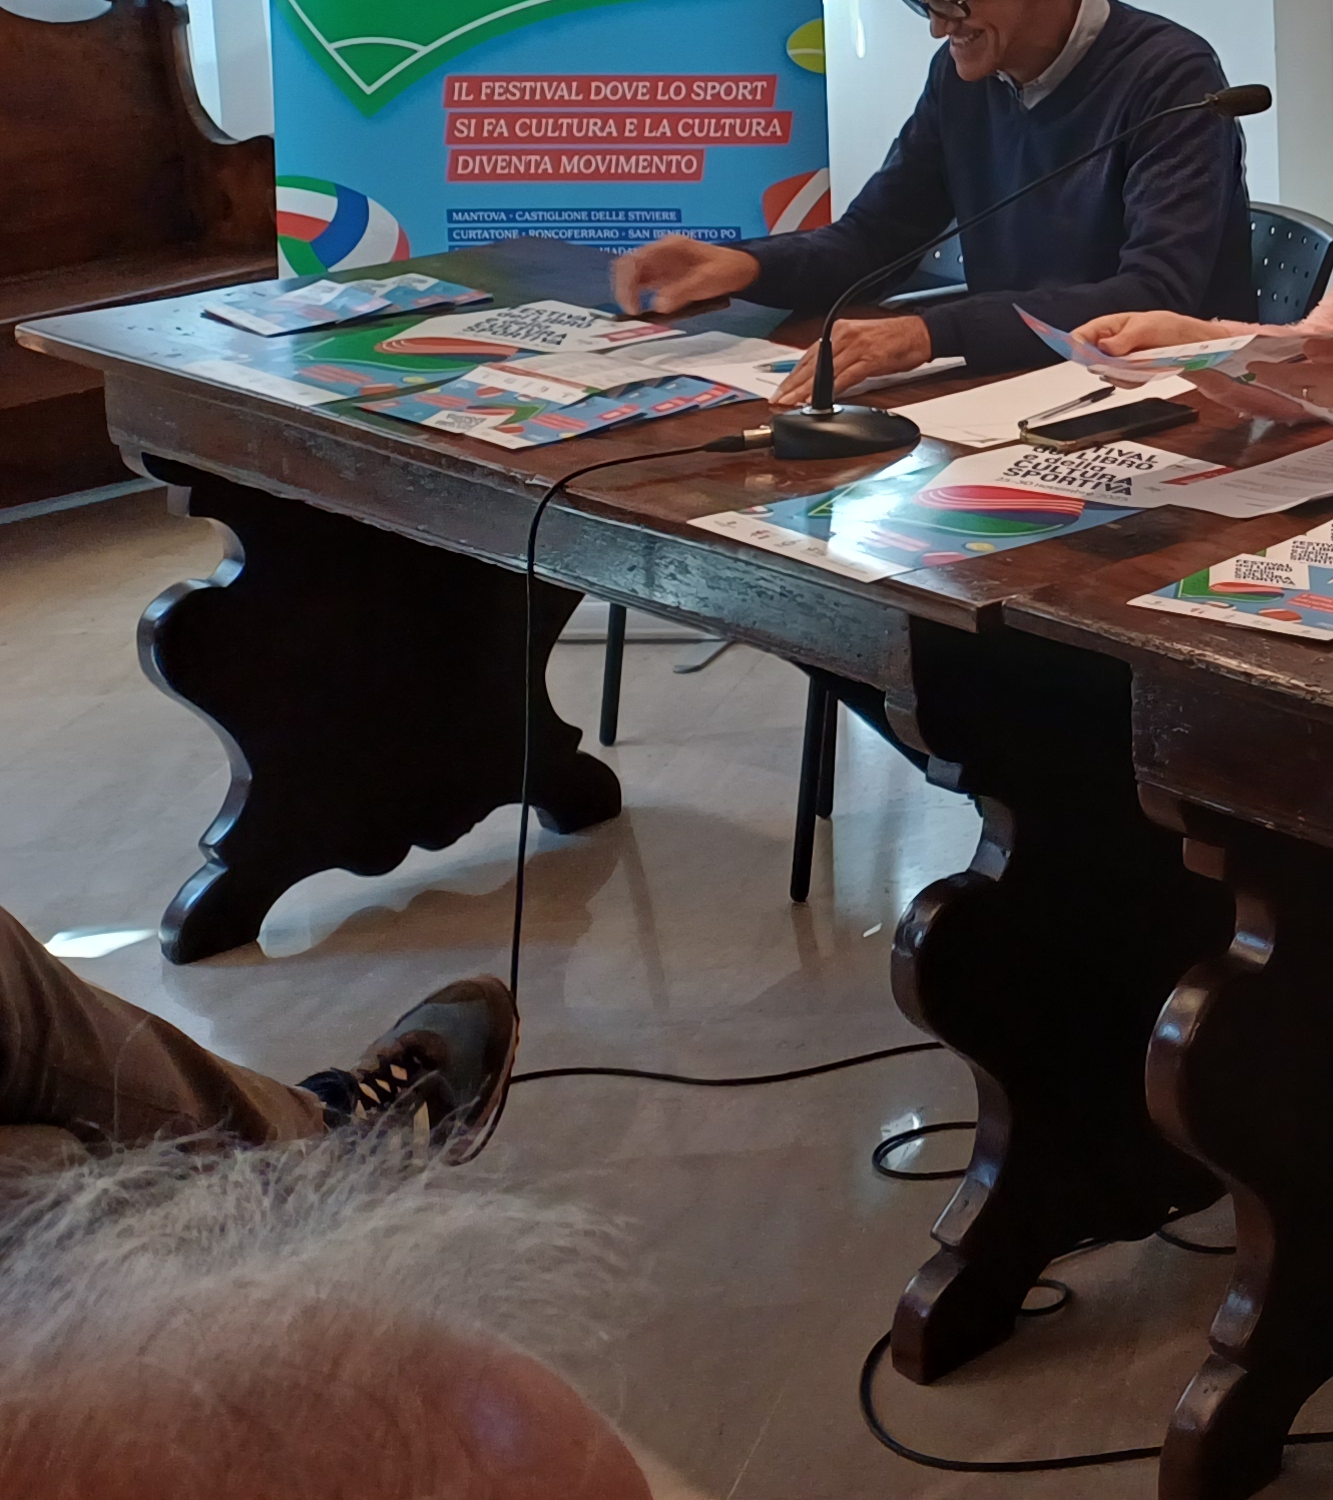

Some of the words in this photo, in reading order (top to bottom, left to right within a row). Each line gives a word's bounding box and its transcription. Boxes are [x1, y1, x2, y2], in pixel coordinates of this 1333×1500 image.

[453, 82, 473, 100] IL
[481, 82, 585, 101] FESTIVAL
[590, 82, 650, 101] DOVE
[656, 82, 687, 101] LO
[692, 81, 767, 101] SPORT
[454, 119, 476, 138] SI
[482, 119, 509, 138] FA
[515, 118, 617, 138] CULTURA
[624, 118, 639, 137] E
[644, 118, 671, 137] LA
[678, 117, 783, 137] CULTURA
[456, 155, 552, 174] DIVENTA
[559, 155, 698, 174] MOVIMENTO
[452, 211, 507, 221] MANTOVA
[515, 211, 590, 221] CASTIGLIONE
[591, 211, 625, 221] DELLE
[628, 211, 677, 221] STIVIERE
[453, 229, 519, 239] CURTATONE
[628, 229, 650, 238] SAN
[720, 229, 736, 238] PO
[1076, 452, 1154, 471] LIBRO
[1088, 444, 1159, 464] TIVAL
[1013, 459, 1132, 486] CULTURA
[1044, 456, 1107, 472] della
[1003, 467, 1132, 496] SPORTIVA
